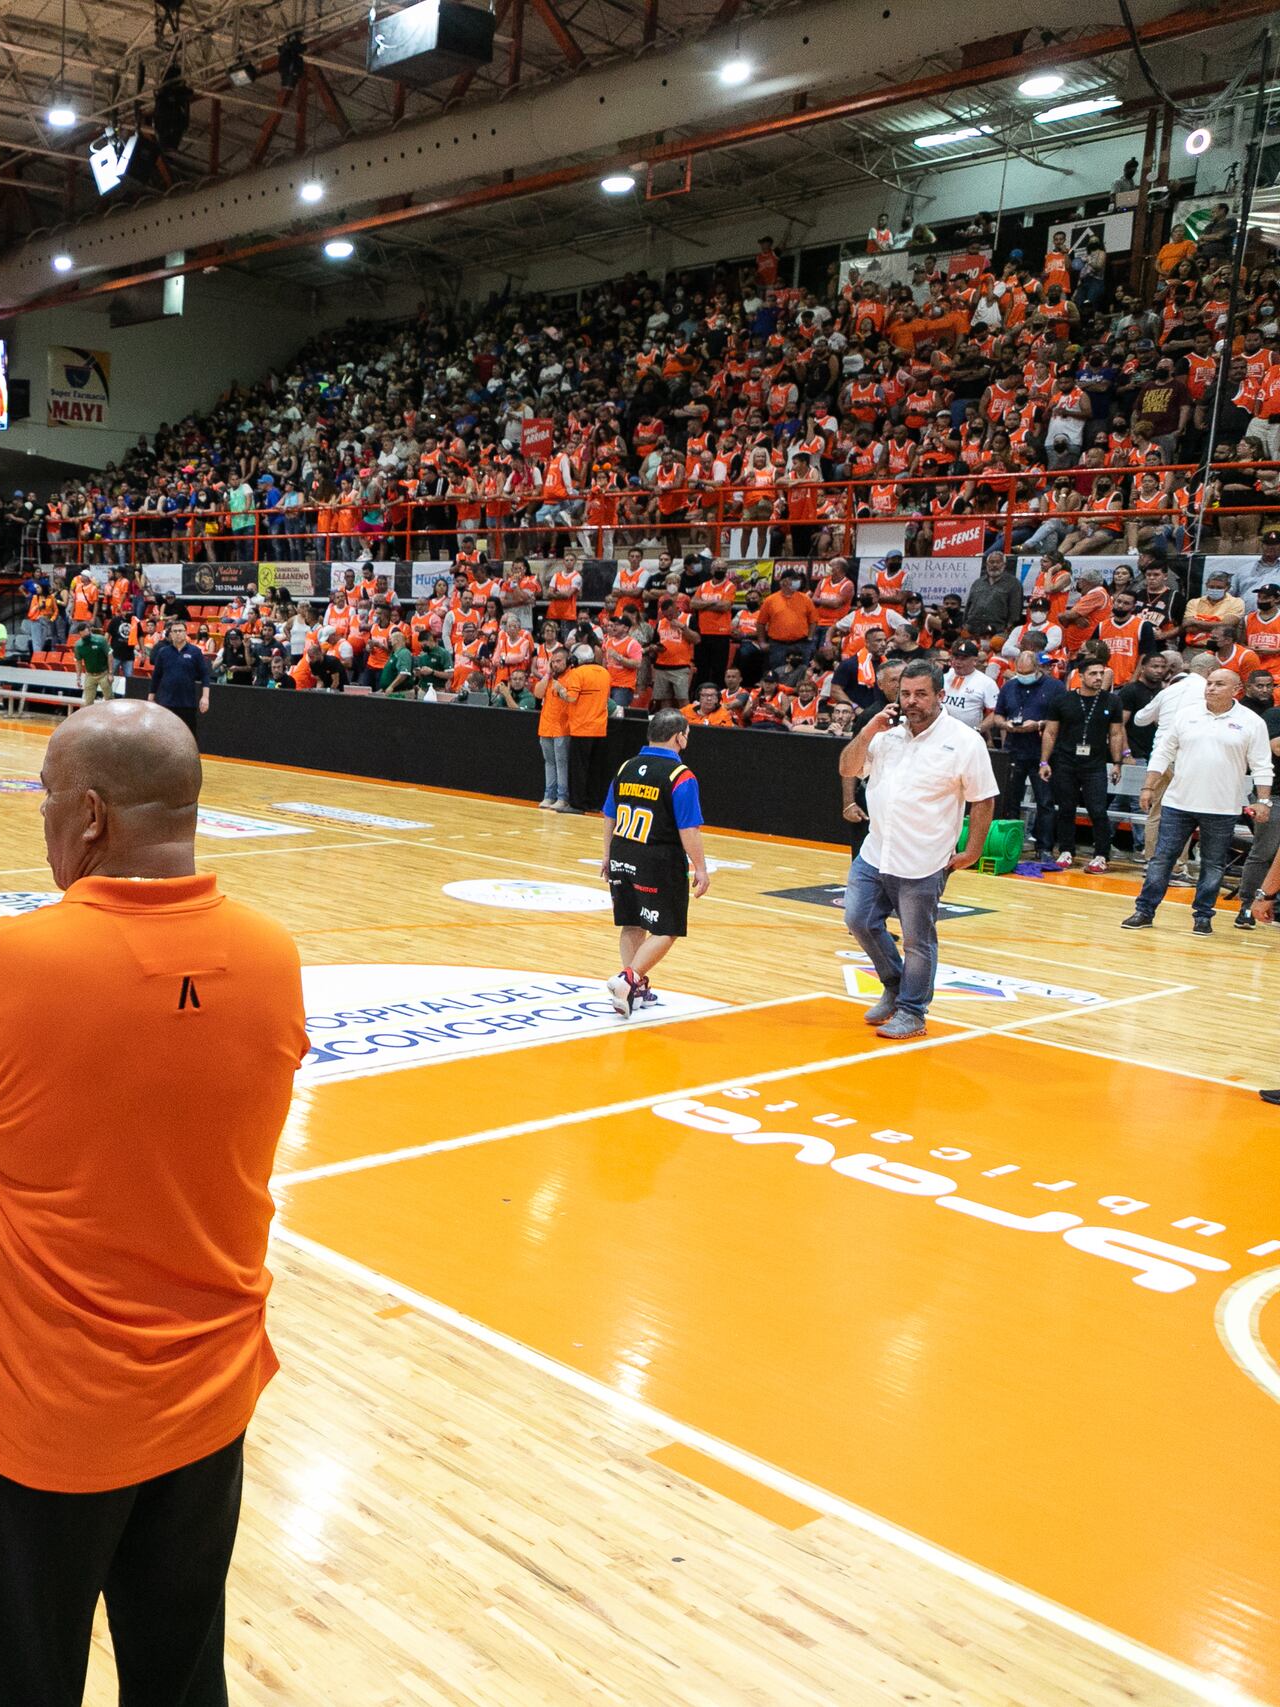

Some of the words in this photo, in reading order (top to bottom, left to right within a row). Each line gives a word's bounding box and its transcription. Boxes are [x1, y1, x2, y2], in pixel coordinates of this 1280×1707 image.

[51, 402, 104, 423] MAYI
[933, 527, 980, 551] DE-FENSE
[924, 560, 969, 572] RAFAEL
[618, 782, 660, 801] MONCHO
[613, 803, 654, 844] 00
[475, 986, 540, 1004] DE
[531, 979, 600, 996] LA
